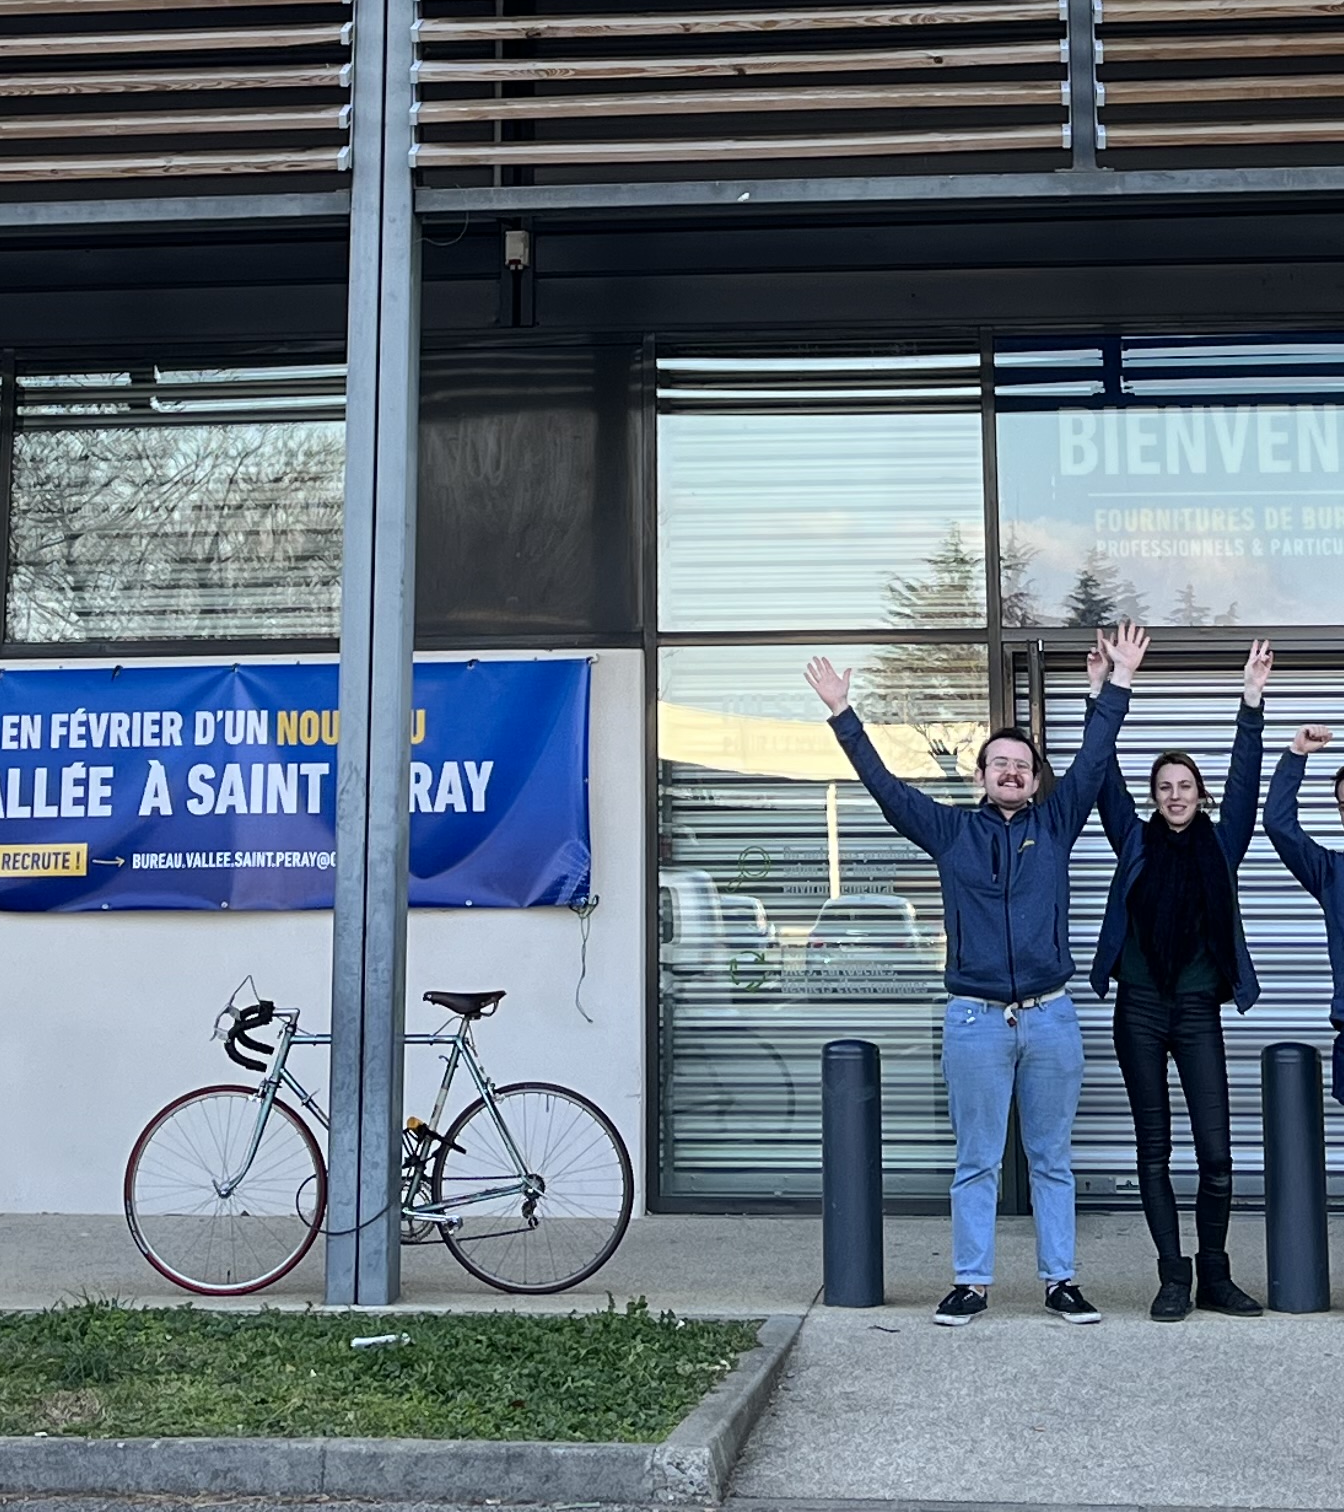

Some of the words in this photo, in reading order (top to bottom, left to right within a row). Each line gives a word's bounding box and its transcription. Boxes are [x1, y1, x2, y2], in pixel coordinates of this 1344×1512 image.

[1094, 506, 1256, 533] FOURNITURES
[1264, 506, 1293, 531] DE
[1096, 538, 1245, 558] PROFESSIONNELS
[1251, 538, 1264, 557] &
[1, 715, 42, 750] EN
[50, 707, 183, 749] FÉVRIER
[194, 710, 268, 746] D'UN
[277, 709, 426, 746] NOUU
[138, 760, 173, 816] À
[186, 763, 330, 815] SAINT
[1, 852, 71, 870] RECRUTE
